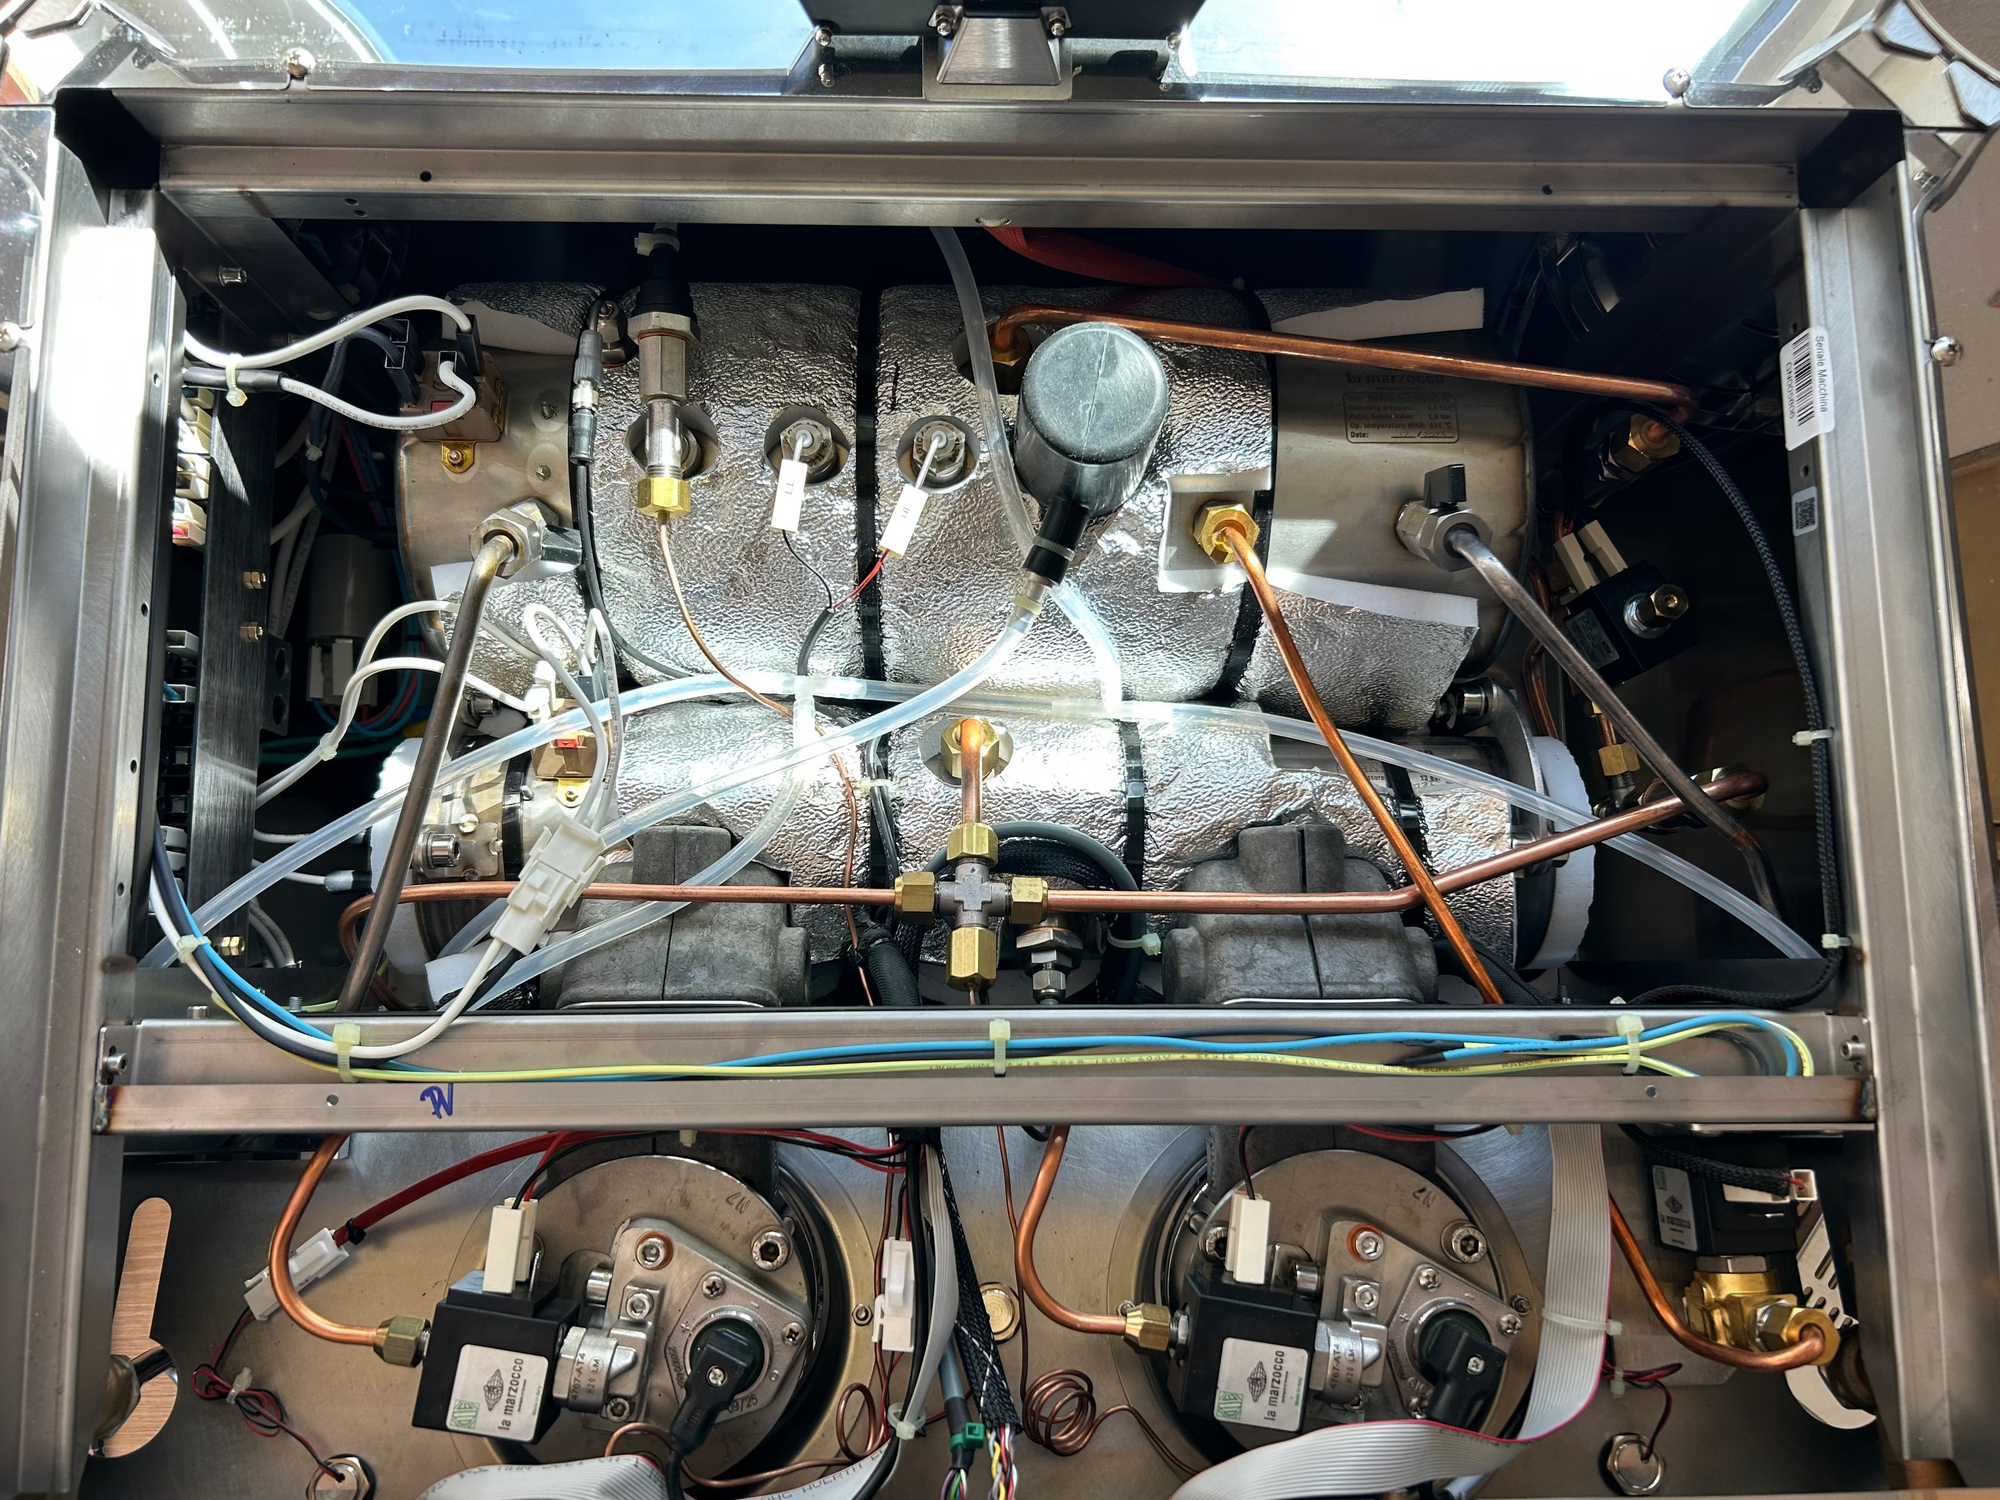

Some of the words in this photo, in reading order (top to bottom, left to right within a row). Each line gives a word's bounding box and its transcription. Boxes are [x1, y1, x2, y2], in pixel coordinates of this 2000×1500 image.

[1815, 334, 1826, 367] Seriale
[1346, 372, 1361, 384] la
[1366, 374, 1445, 384] marzocco
[1817, 368, 1828, 413] Macchina
[503, 1357, 524, 1418] marzocco
[571, 1352, 586, 1401] 4767-AT4
[1268, 1350, 1285, 1408] marzocco
[498, 1418, 511, 1431] la
[1263, 1410, 1277, 1422] la
